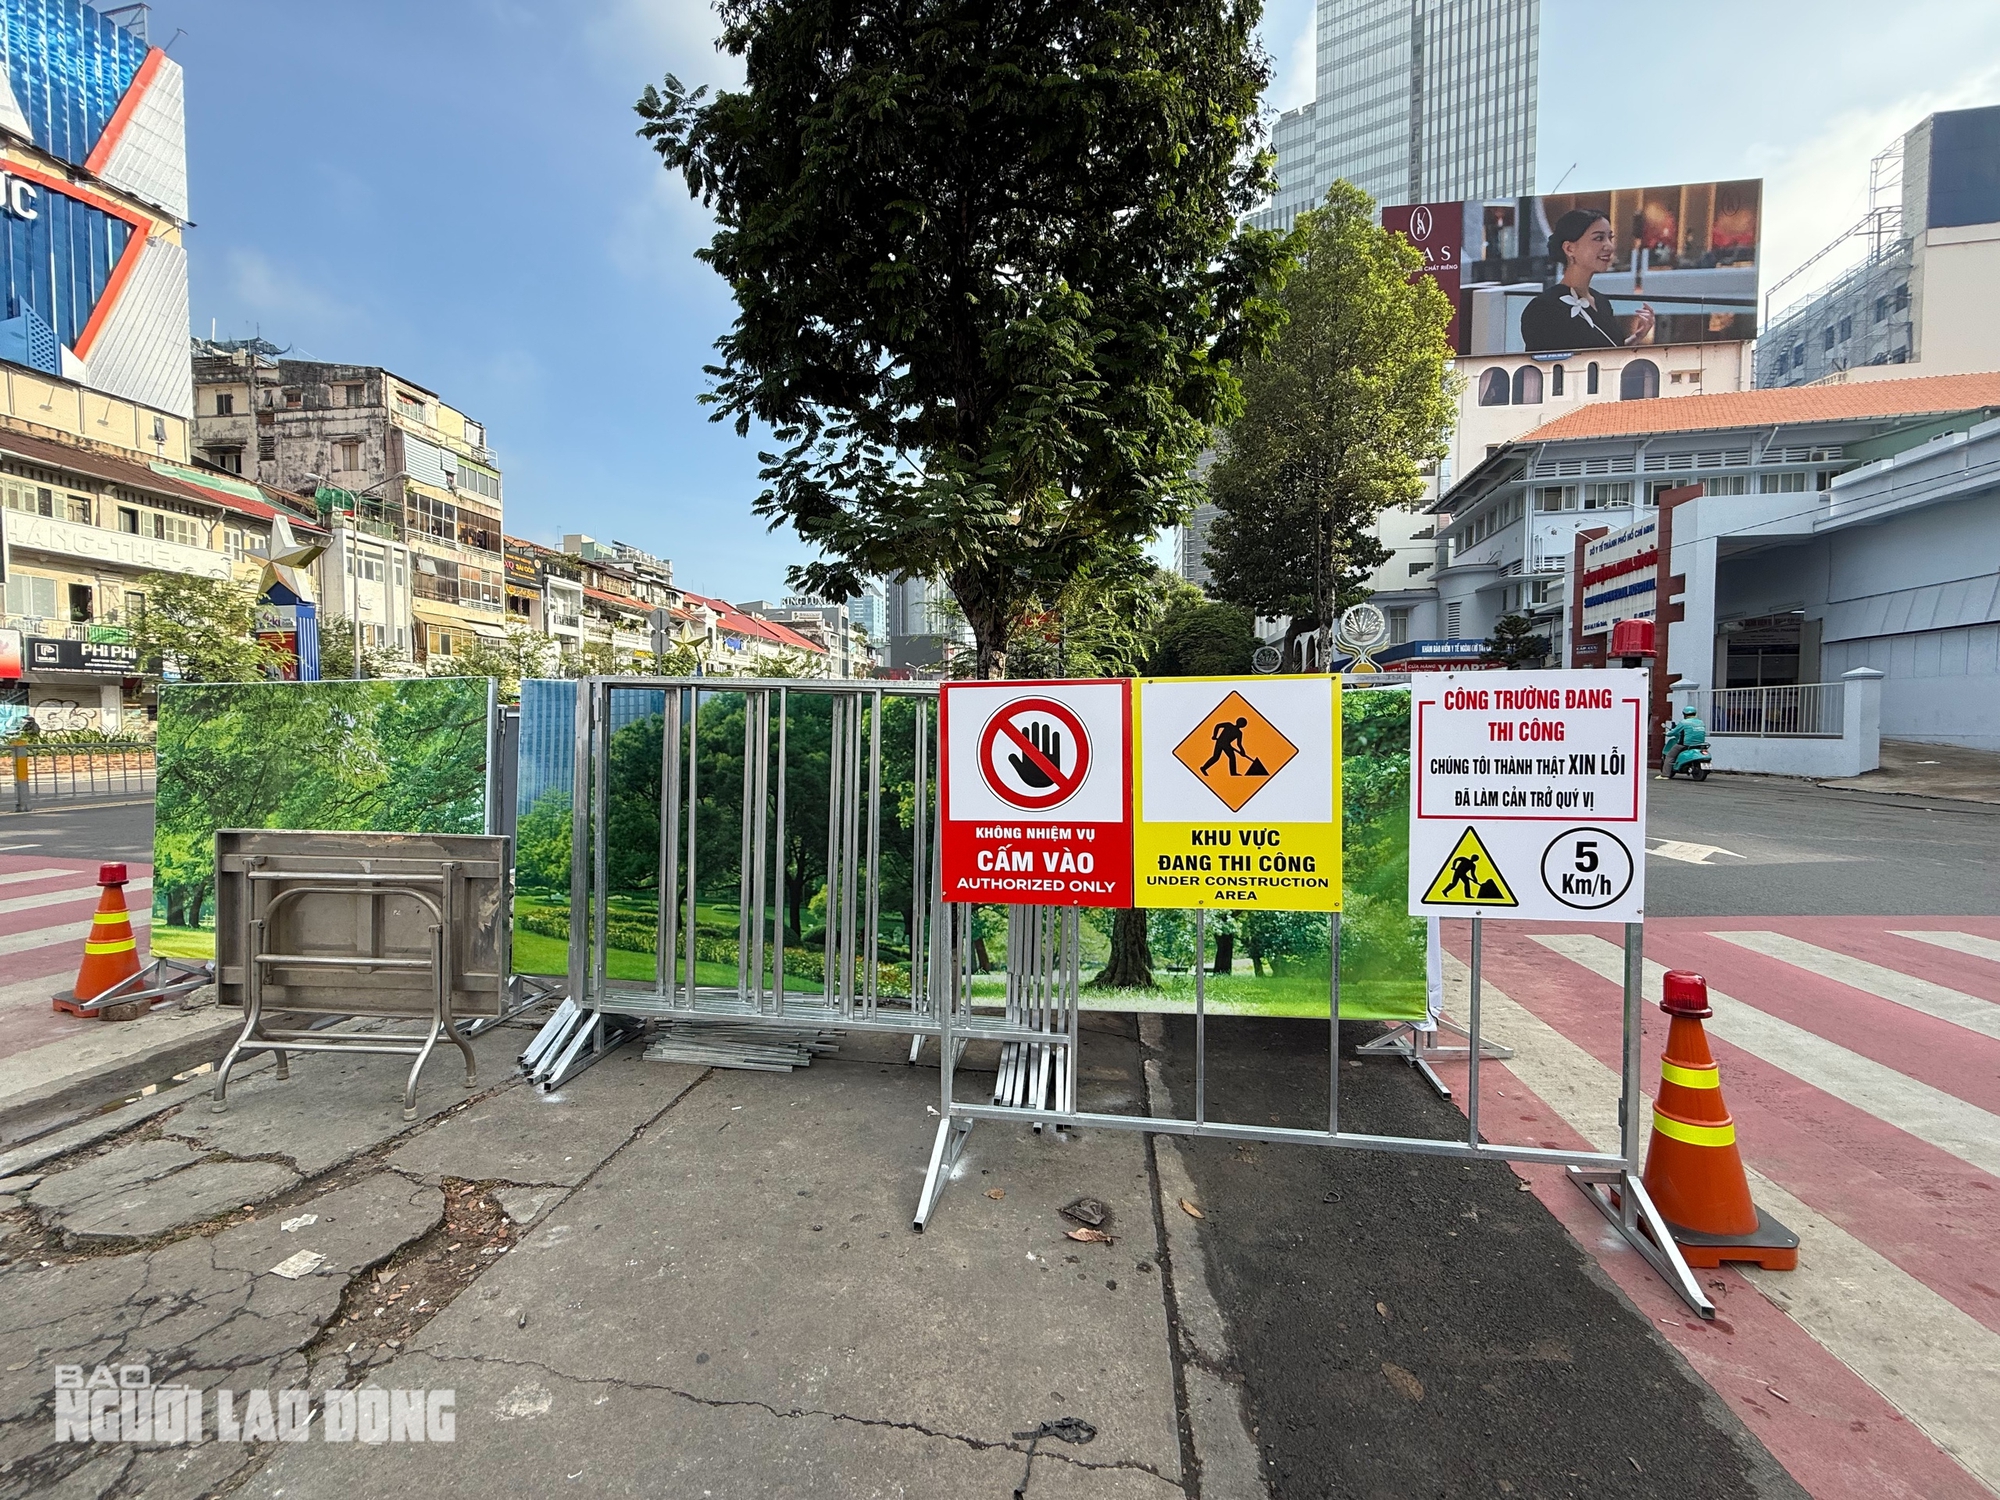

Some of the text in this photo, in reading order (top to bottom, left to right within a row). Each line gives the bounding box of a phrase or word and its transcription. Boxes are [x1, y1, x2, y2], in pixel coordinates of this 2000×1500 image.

[1618, 531, 1627, 545] PHỐ
[780, 597, 803, 606] KING
[1450, 663, 1488, 672] MART
[1444, 685, 1612, 710] CÔNG TRƯỜNG ĐANG
[1488, 717, 1565, 741] THI CÔNG
[1430, 746, 1625, 778] CHÚNG TÔI THÀNH THẬT XIN LỖI
[1455, 786, 1594, 812] ĐÃ LÀM CẢN TRỞ QUÝ VỊ
[976, 824, 1095, 842] KHÔNG NHIỆM VỤ
[1191, 828, 1280, 850] KHU VỰC
[977, 844, 1094, 874] CẤM VÀO
[1158, 852, 1316, 872] ĐANG THI CÔNG
[1575, 841, 1599, 873] 5
[956, 877, 1116, 893] AUTHORIZED ONLY
[1146, 876, 1329, 887] UNDER CONSTRUCTION
[1562, 873, 1612, 897] Km/h
[1214, 891, 1258, 900] AREA
